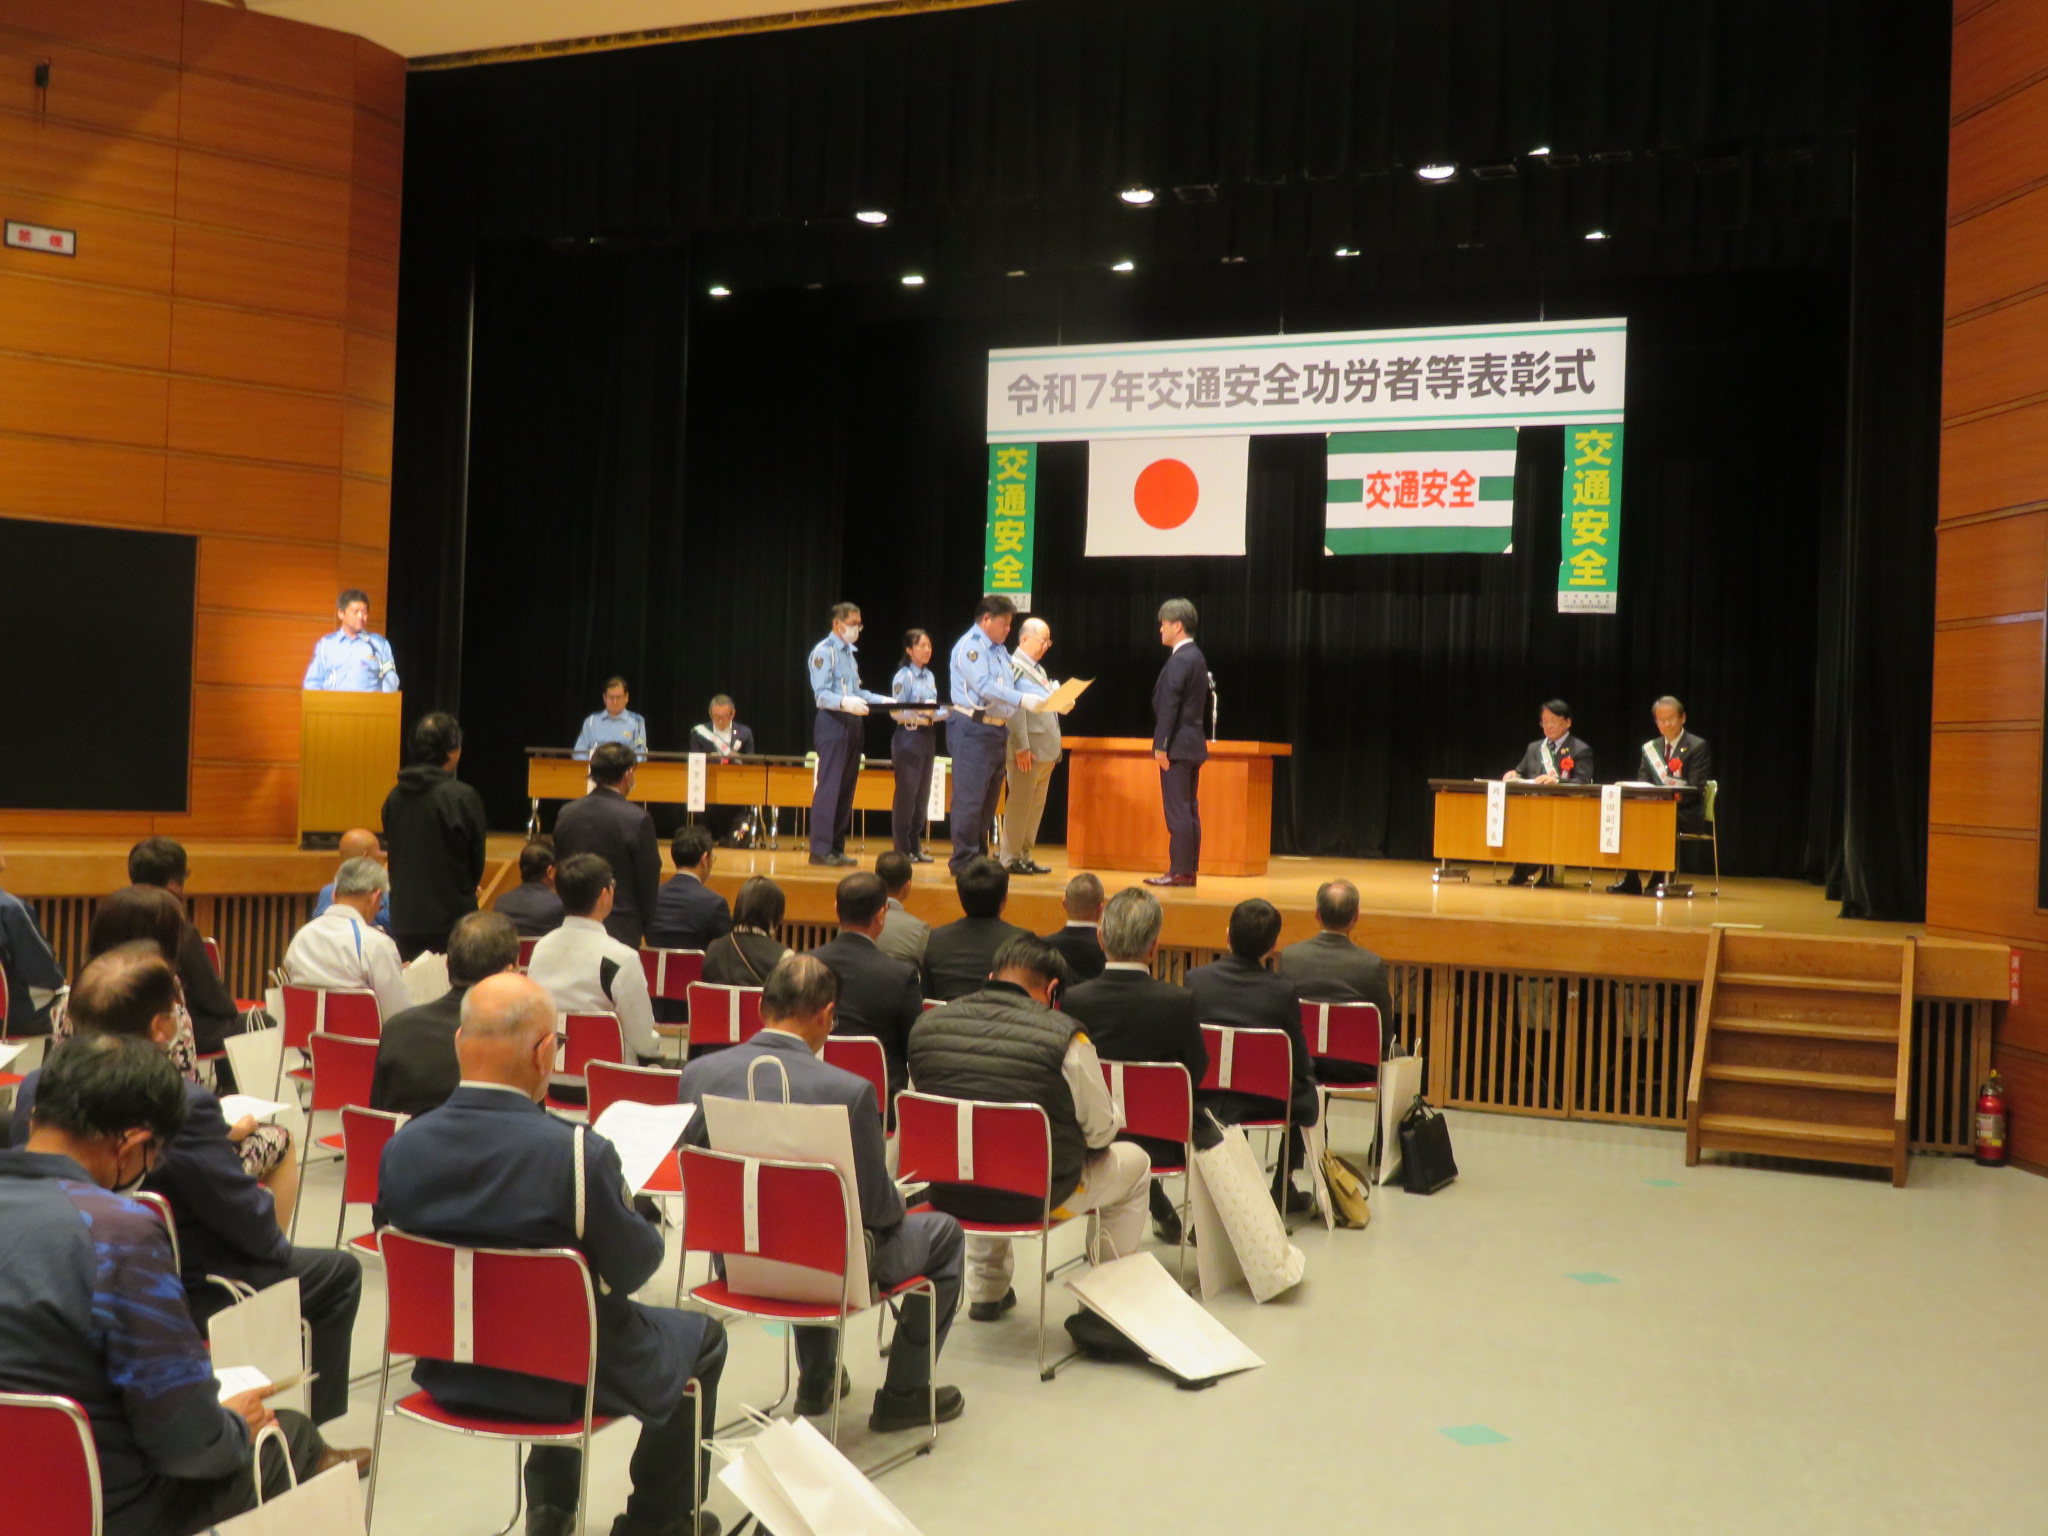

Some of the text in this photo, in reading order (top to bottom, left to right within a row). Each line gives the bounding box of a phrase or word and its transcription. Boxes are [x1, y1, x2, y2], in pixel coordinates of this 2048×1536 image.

[1006, 347, 1597, 416] 令和7年交通安全功労者等表彰式
[991, 446, 1028, 589] 交通安全
[1365, 468, 1477, 510] 交通安全
[1567, 429, 1614, 587] 交通安全
[1491, 786, 1501, 842] 岡崎市長
[1604, 789, 1616, 849] 幸田副町長
